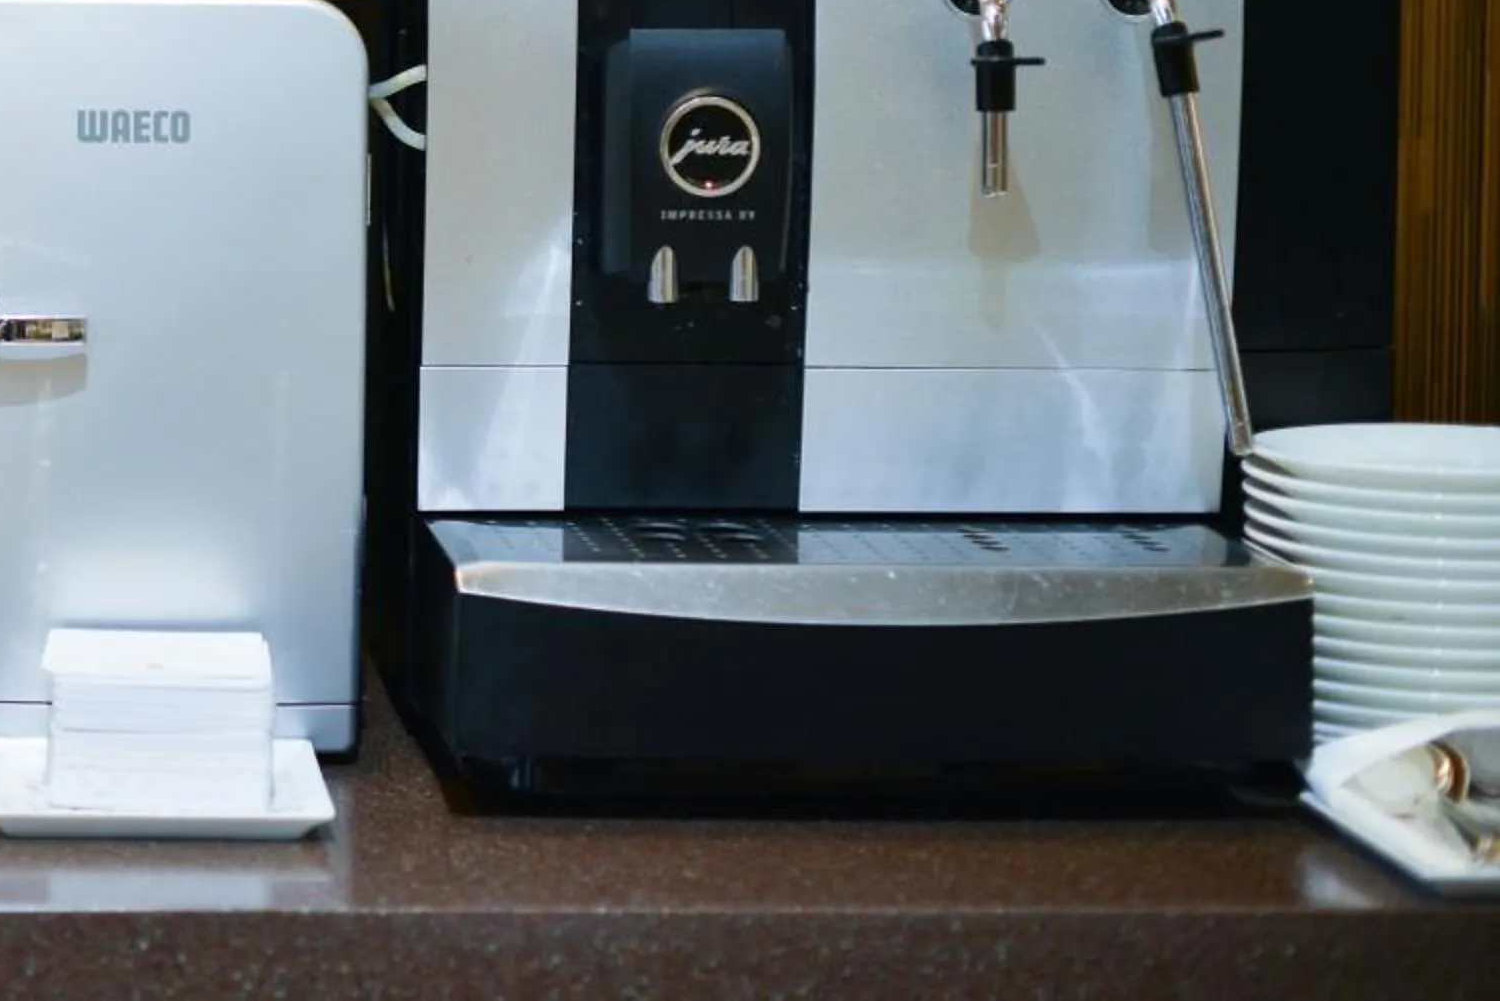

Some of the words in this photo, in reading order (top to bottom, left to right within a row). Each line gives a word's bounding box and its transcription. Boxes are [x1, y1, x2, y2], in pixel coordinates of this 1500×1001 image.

[77, 109, 191, 144] WAECO
[669, 128, 751, 167] jura
[660, 209, 732, 221] IMPRESSA
